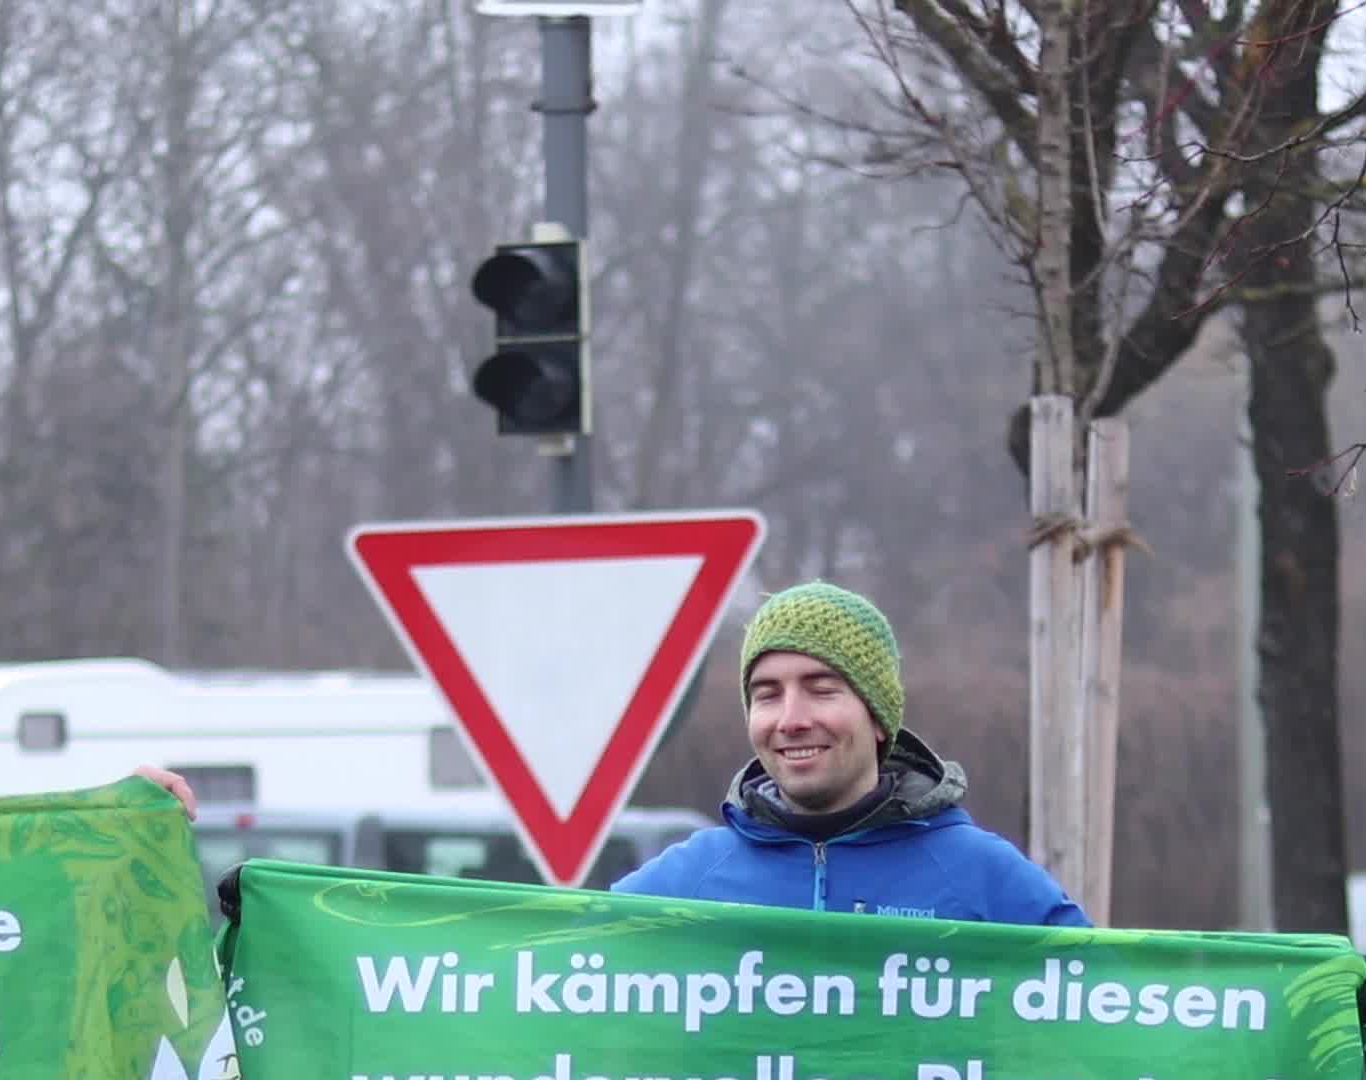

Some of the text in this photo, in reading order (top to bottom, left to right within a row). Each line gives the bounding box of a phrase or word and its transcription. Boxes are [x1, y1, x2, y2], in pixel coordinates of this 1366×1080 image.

[356, 950, 1266, 1032] Wir kämpfen für diesen
